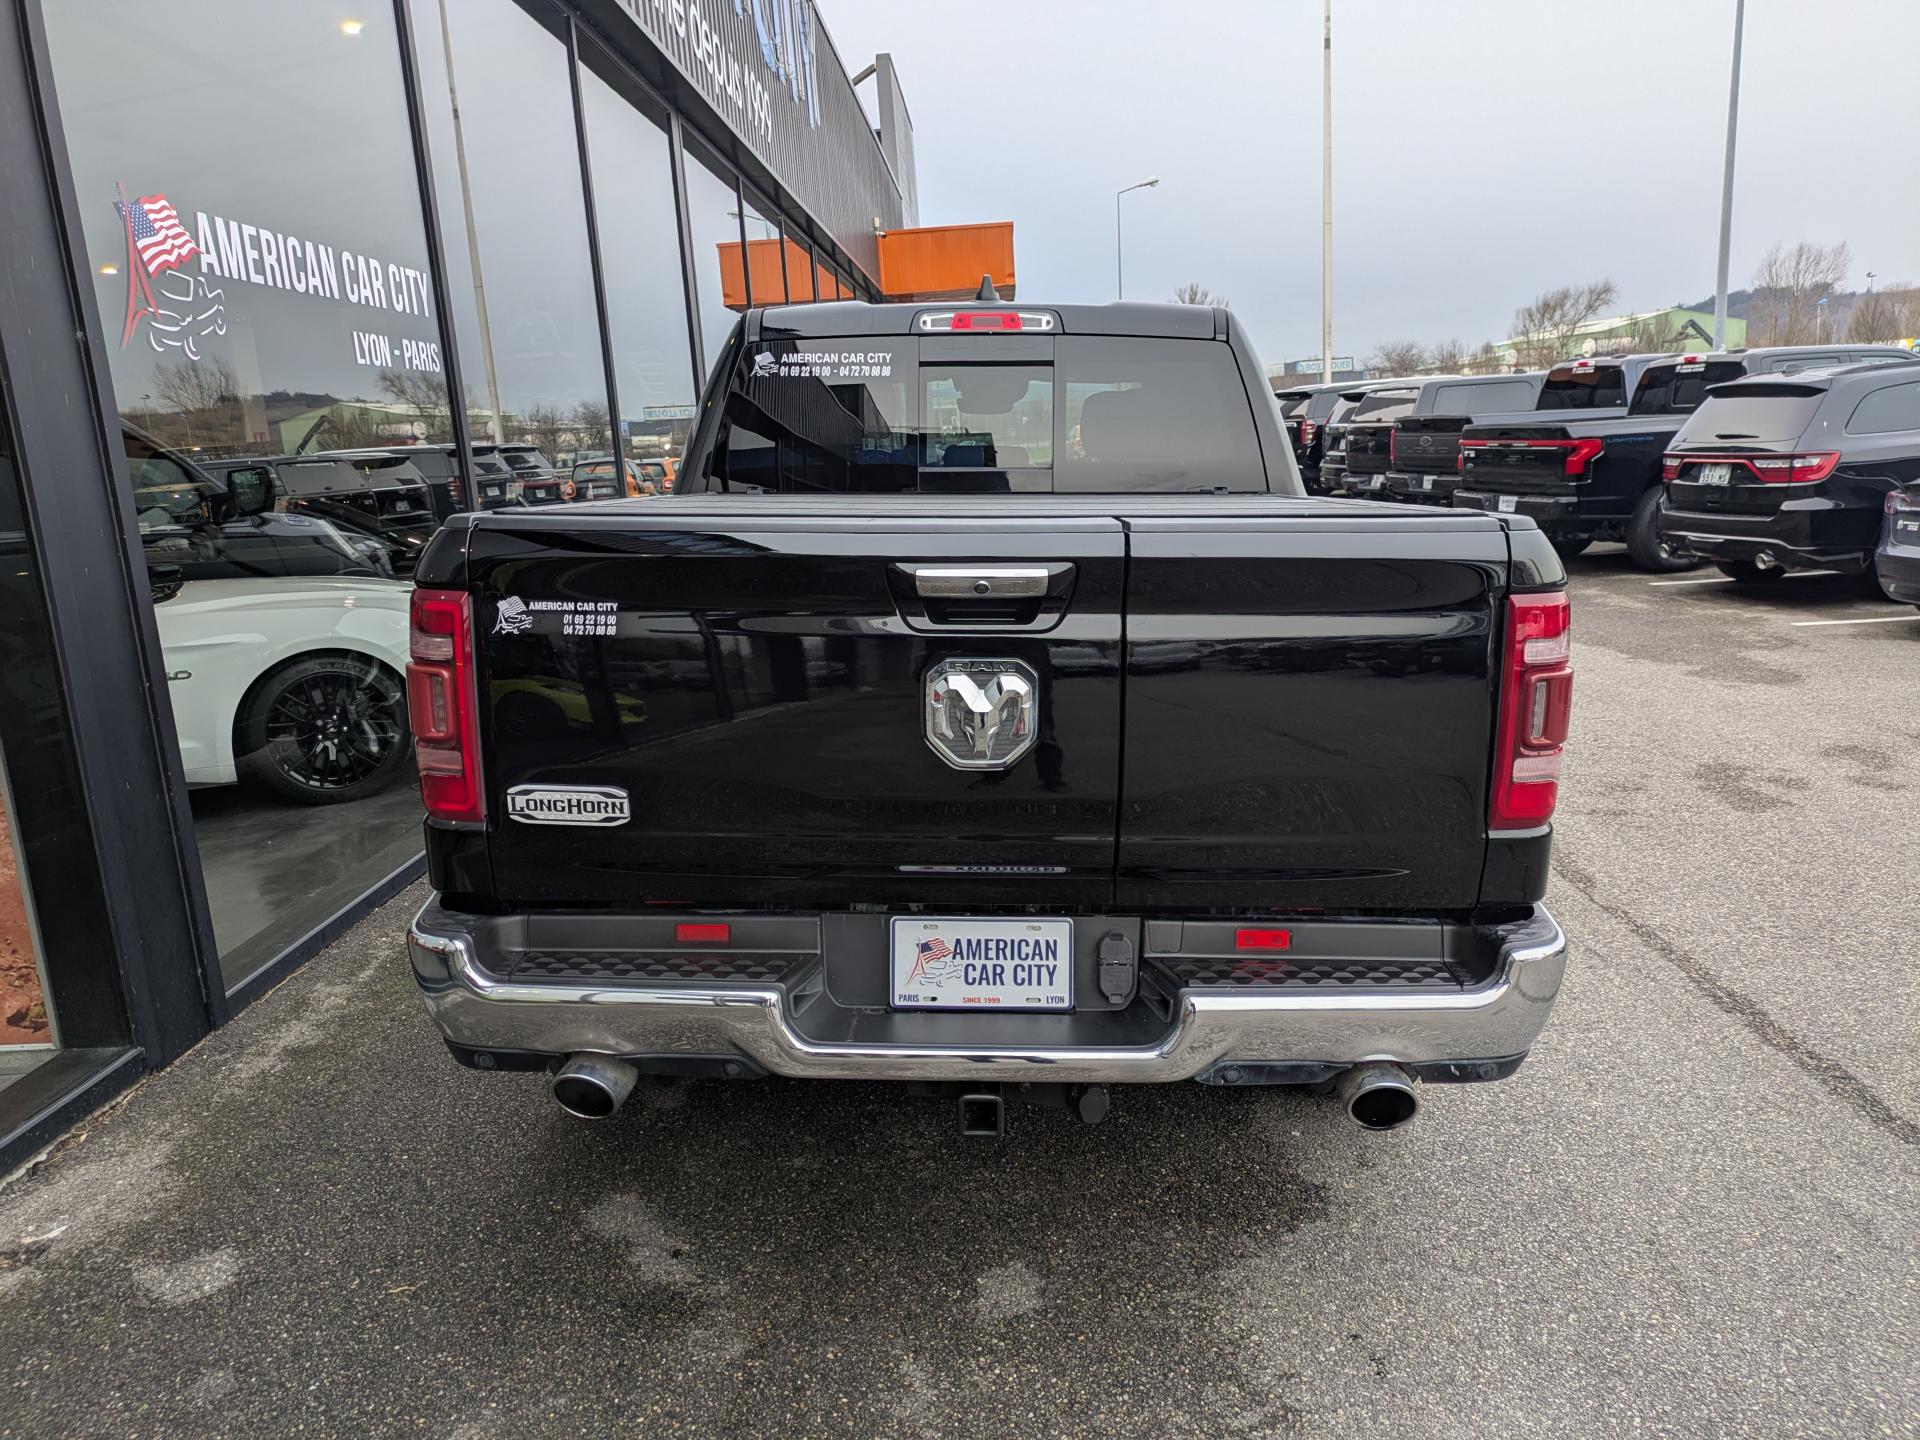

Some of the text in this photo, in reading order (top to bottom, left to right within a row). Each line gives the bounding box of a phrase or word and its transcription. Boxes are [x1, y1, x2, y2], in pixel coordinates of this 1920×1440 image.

[689, 0, 743, 110] depuis
[744, 63, 772, 143] 1999
[196, 211, 430, 317] AMERICAN CAR CITY
[353, 331, 392, 367] LYON
[402, 338, 441, 373] PARIS
[781, 353, 892, 363] AMERICAN CAR CITY
[780, 366, 789, 377] 01
[790, 366, 800, 377] 69
[801, 366, 810, 377] 22
[811, 366, 820, 377] 19
[821, 366, 831, 377] 00
[840, 366, 849, 377] 04
[850, 366, 860, 377] 72
[860, 366, 870, 377] 70
[871, 366, 880, 377] 88
[881, 366, 891, 377] 88
[529, 601, 618, 611] AMERICAN CAR CITY
[563, 614, 616, 624] 01 69 22 19 00
[563, 625, 616, 635] 04 72 70 88 88
[946, 661, 1016, 671] RAM
[510, 796, 627, 815] LONGHORN
[952, 937, 1058, 961] AMERICAN
[964, 963, 1058, 987] CAR CITY
[898, 994, 920, 1003] PARIS
[1046, 995, 1065, 1004] LYON
